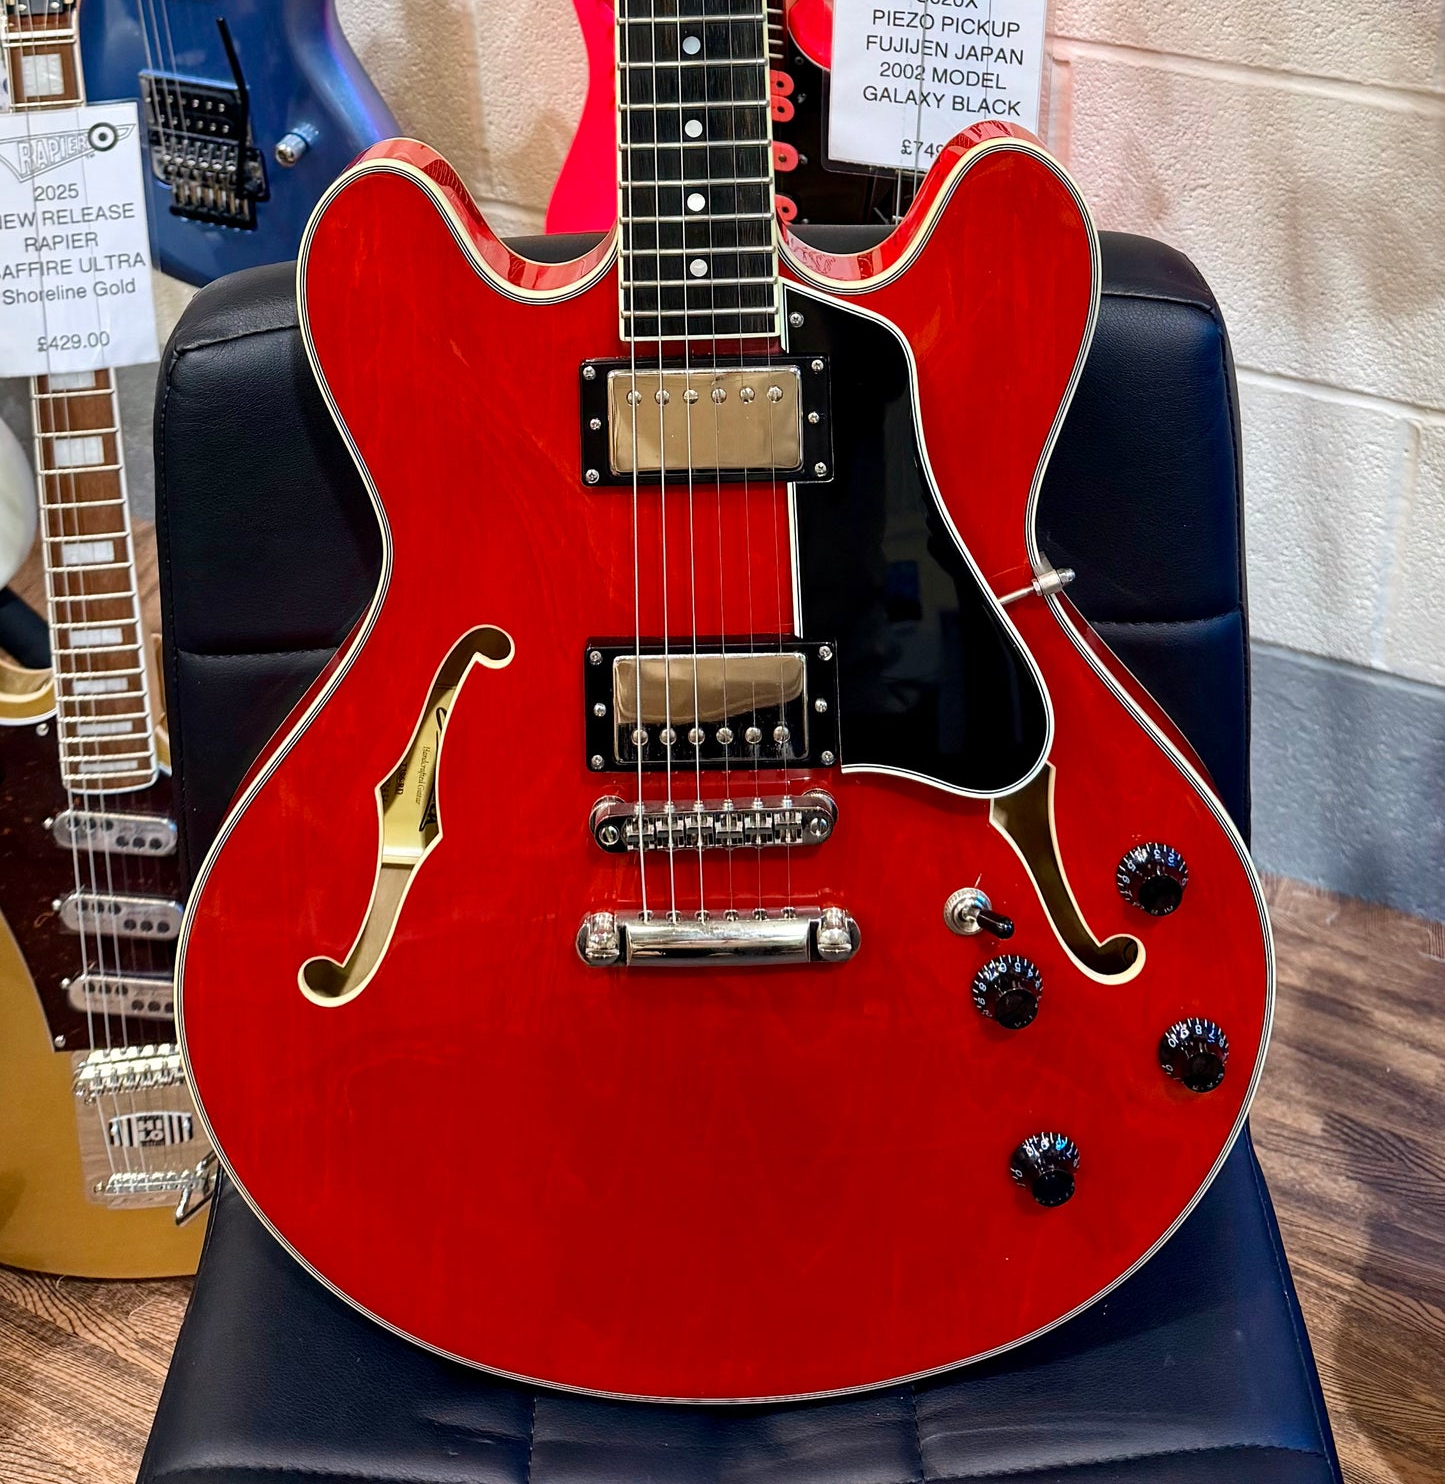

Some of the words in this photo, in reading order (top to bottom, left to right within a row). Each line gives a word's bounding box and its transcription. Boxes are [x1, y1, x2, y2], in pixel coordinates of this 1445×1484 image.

[872, 9, 935, 30] PIEZO
[941, 15, 1021, 39] PICKUP
[865, 35, 949, 58] FUJIJEN
[954, 45, 1025, 66] JAPAN
[879, 62, 926, 82] 2002
[931, 67, 1008, 90] MODEL
[862, 85, 946, 110] GALAXY
[951, 94, 1022, 117] BLACK
[18, 132, 88, 176] RAPIER
[34, 183, 79, 202] 2025
[0, 212, 36, 229] EW
[42, 202, 136, 227] RELEASE
[24, 232, 99, 252] RAPIER
[0, 259, 73, 280] AFFIRE
[79, 252, 146, 273] ULTRA
[2, 284, 87, 305] Shoreline
[94, 278, 136, 297] Gold
[37, 331, 111, 353] £429.00
